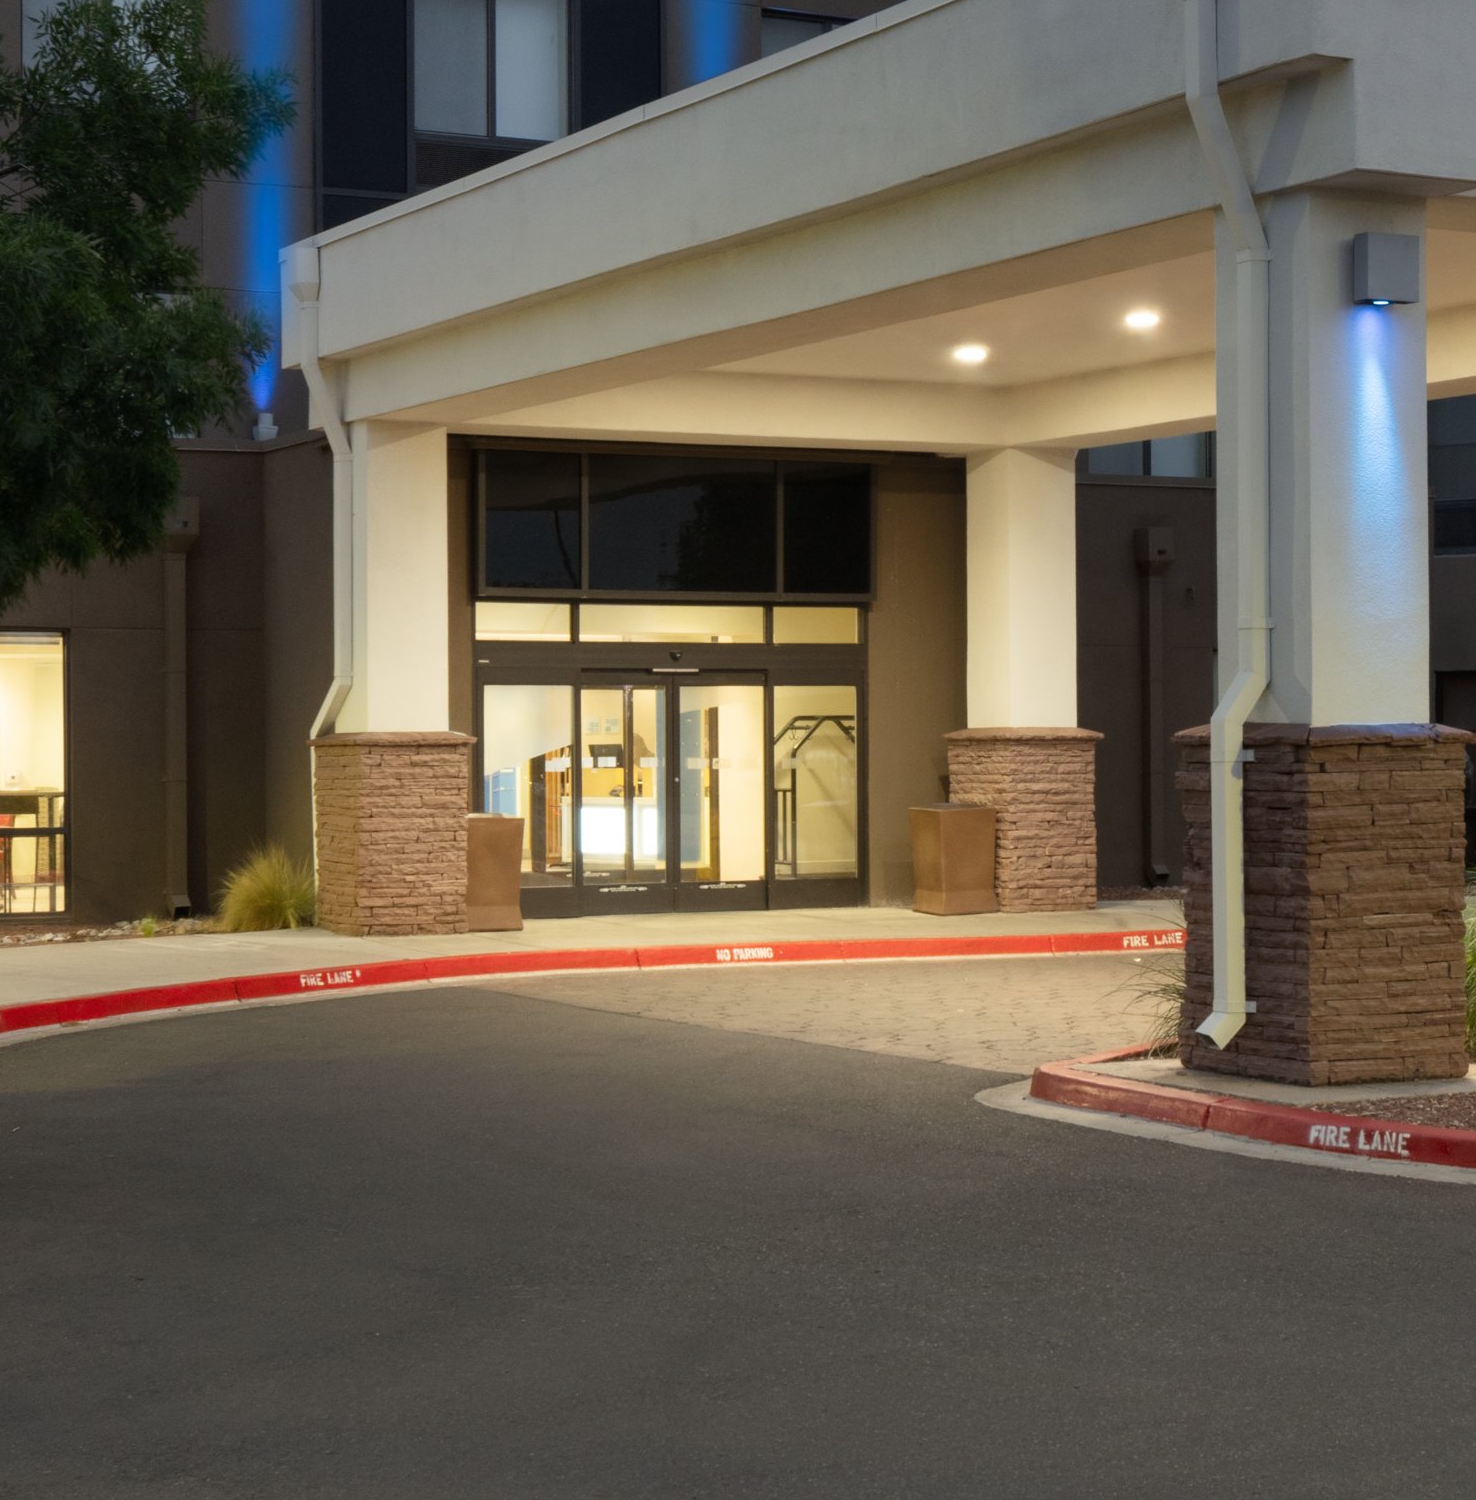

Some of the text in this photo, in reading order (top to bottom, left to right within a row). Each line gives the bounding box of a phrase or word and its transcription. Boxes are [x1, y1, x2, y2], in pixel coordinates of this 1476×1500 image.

[1122, 932, 1183, 948] FIRE LANE
[716, 947, 774, 961] NO PARKING
[300, 970, 354, 988] FIRE LANE
[1308, 1124, 1411, 1156] FIRE LANE
